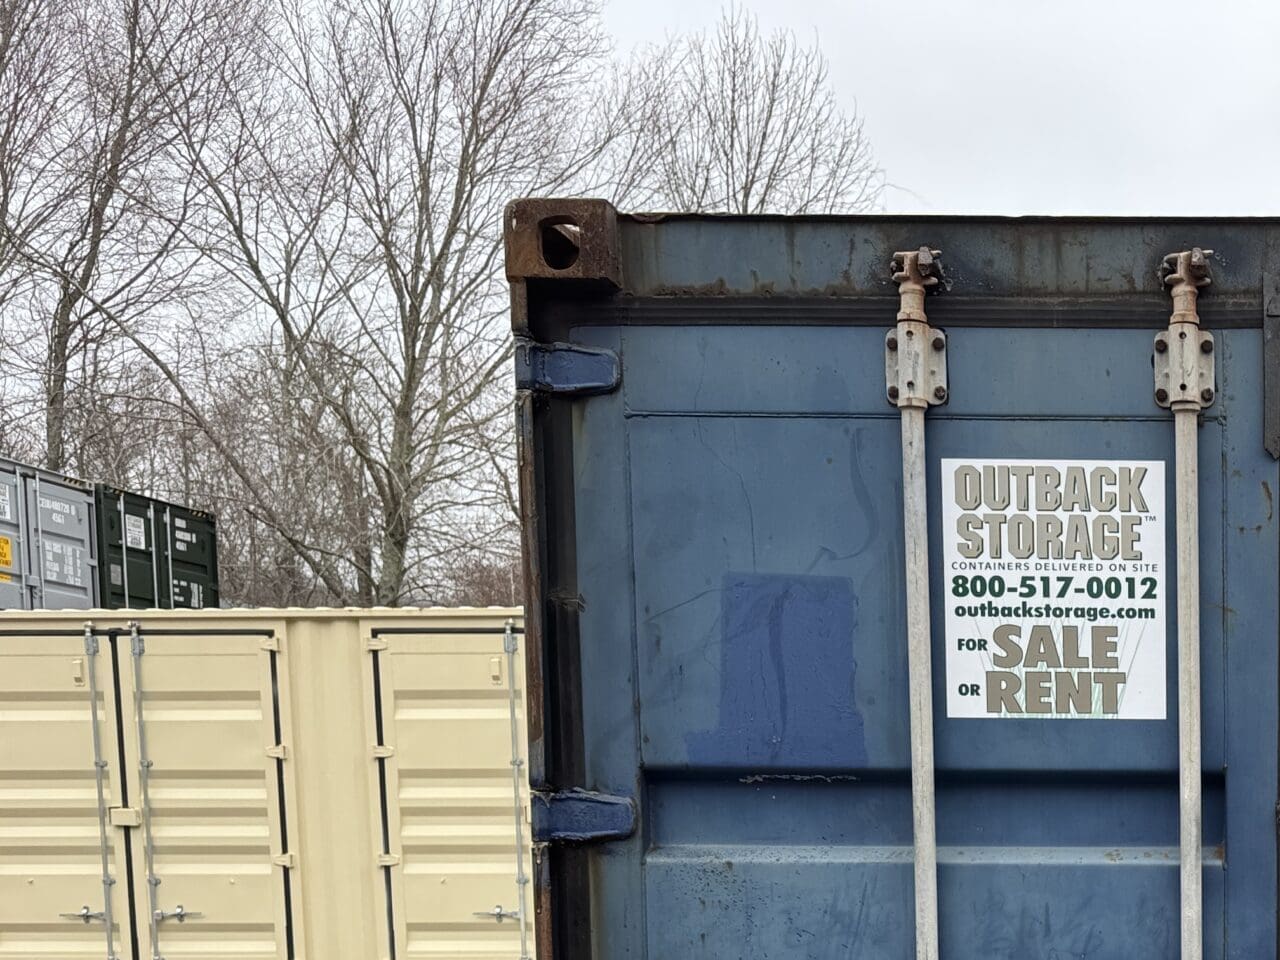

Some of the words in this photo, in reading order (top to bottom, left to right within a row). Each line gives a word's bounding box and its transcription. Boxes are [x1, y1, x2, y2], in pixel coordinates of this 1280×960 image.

[954, 465, 1149, 512] OUTBACK
[957, 513, 1142, 560] STORAGE
[951, 561, 1030, 571] CONTAINERS
[1035, 562, 1103, 572] DELIVERED
[1109, 564, 1127, 572] ON
[1132, 563, 1159, 572] SITE
[951, 575, 1158, 599] 800-517-0012
[954, 601, 1155, 621] outbackstorage.com
[957, 638, 988, 651] FOR
[992, 624, 1119, 669] SALE
[958, 683, 981, 696] OR
[986, 671, 1127, 714] RENT
